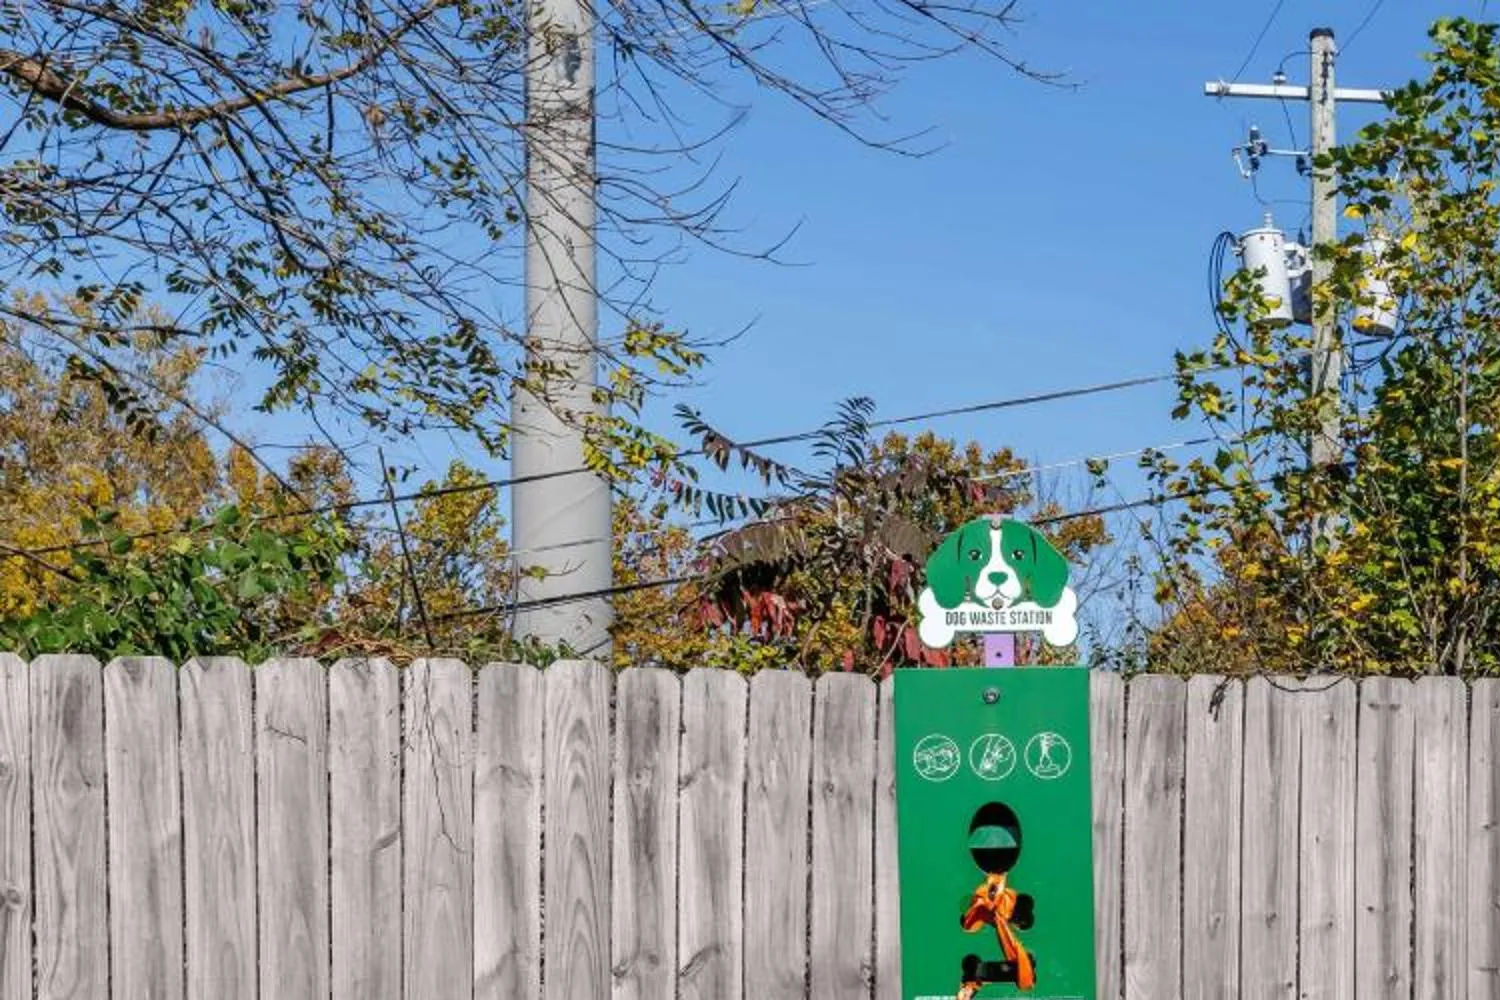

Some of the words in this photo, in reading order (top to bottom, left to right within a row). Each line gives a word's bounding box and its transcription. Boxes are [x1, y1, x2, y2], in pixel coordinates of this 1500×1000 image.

[945, 611, 967, 625] DOG
[969, 611, 1007, 625] WASTE
[1009, 610, 1053, 625] STATION
